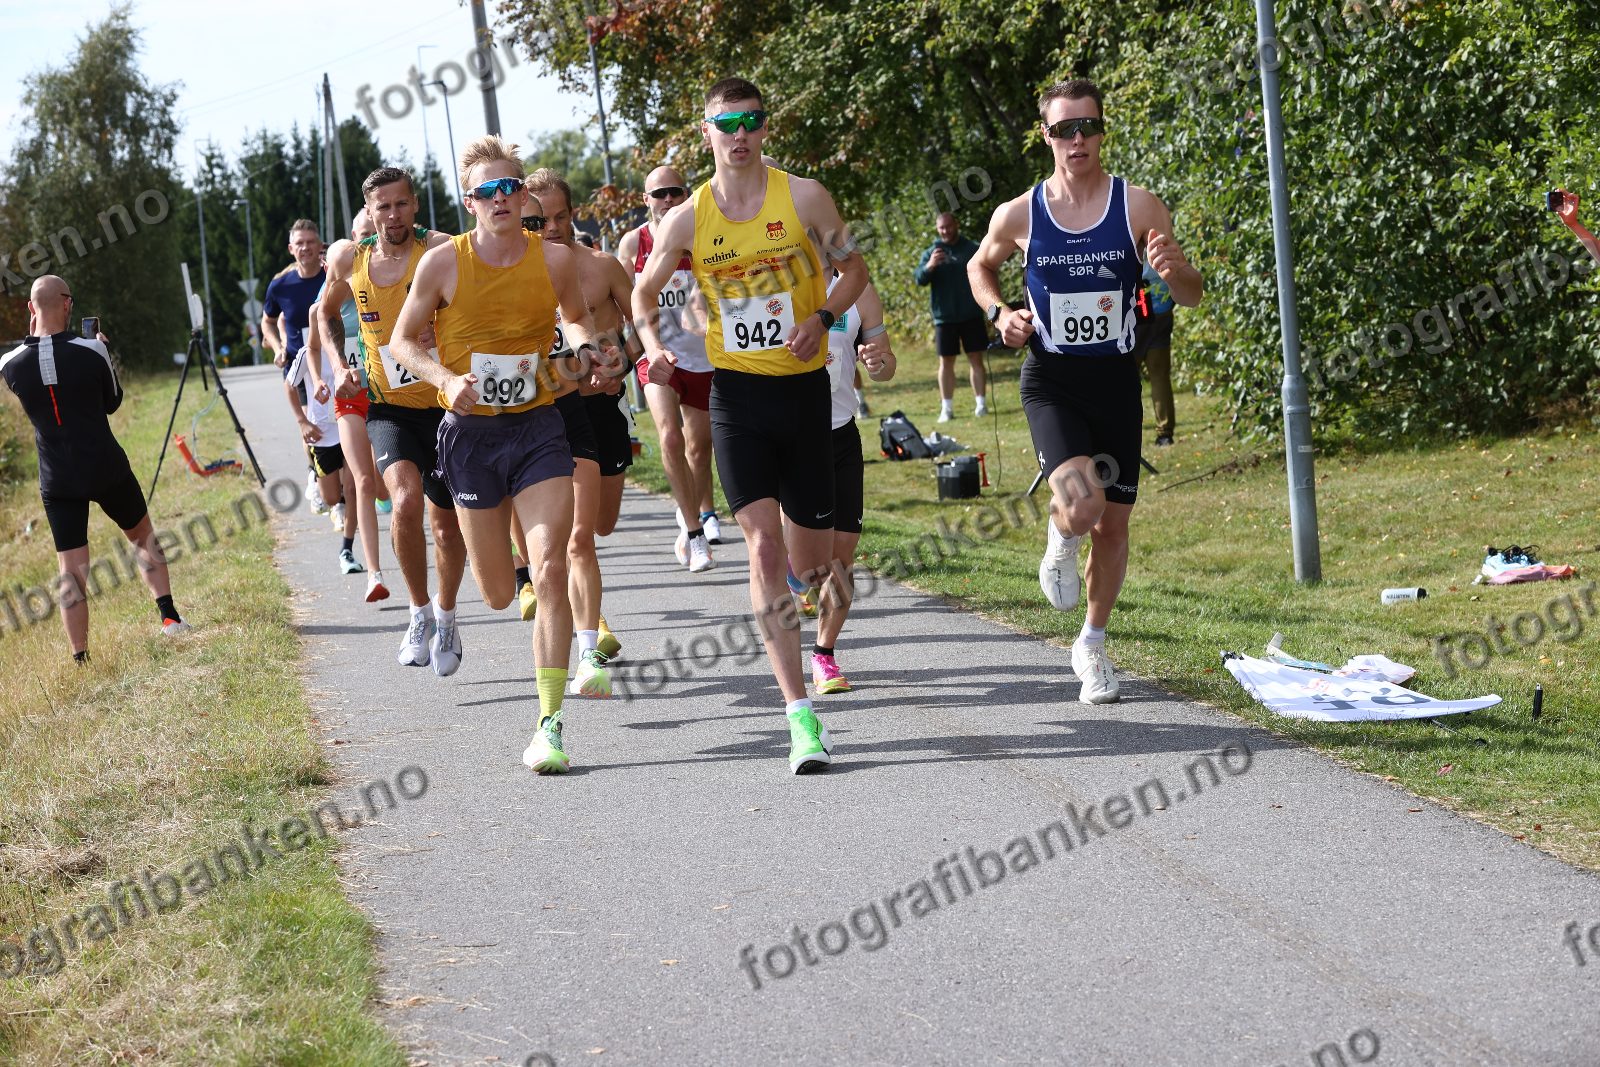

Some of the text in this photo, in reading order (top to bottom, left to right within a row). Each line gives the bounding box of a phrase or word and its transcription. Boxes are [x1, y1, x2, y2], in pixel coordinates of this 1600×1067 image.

[1036, 250, 1125, 267] SPAREBANKEN
[1069, 266, 1095, 277] SØR
[734, 319, 784, 350] 942
[1064, 315, 1109, 343] 993
[482, 377, 526, 404] 992
[457, 492, 478, 501] HOKA
